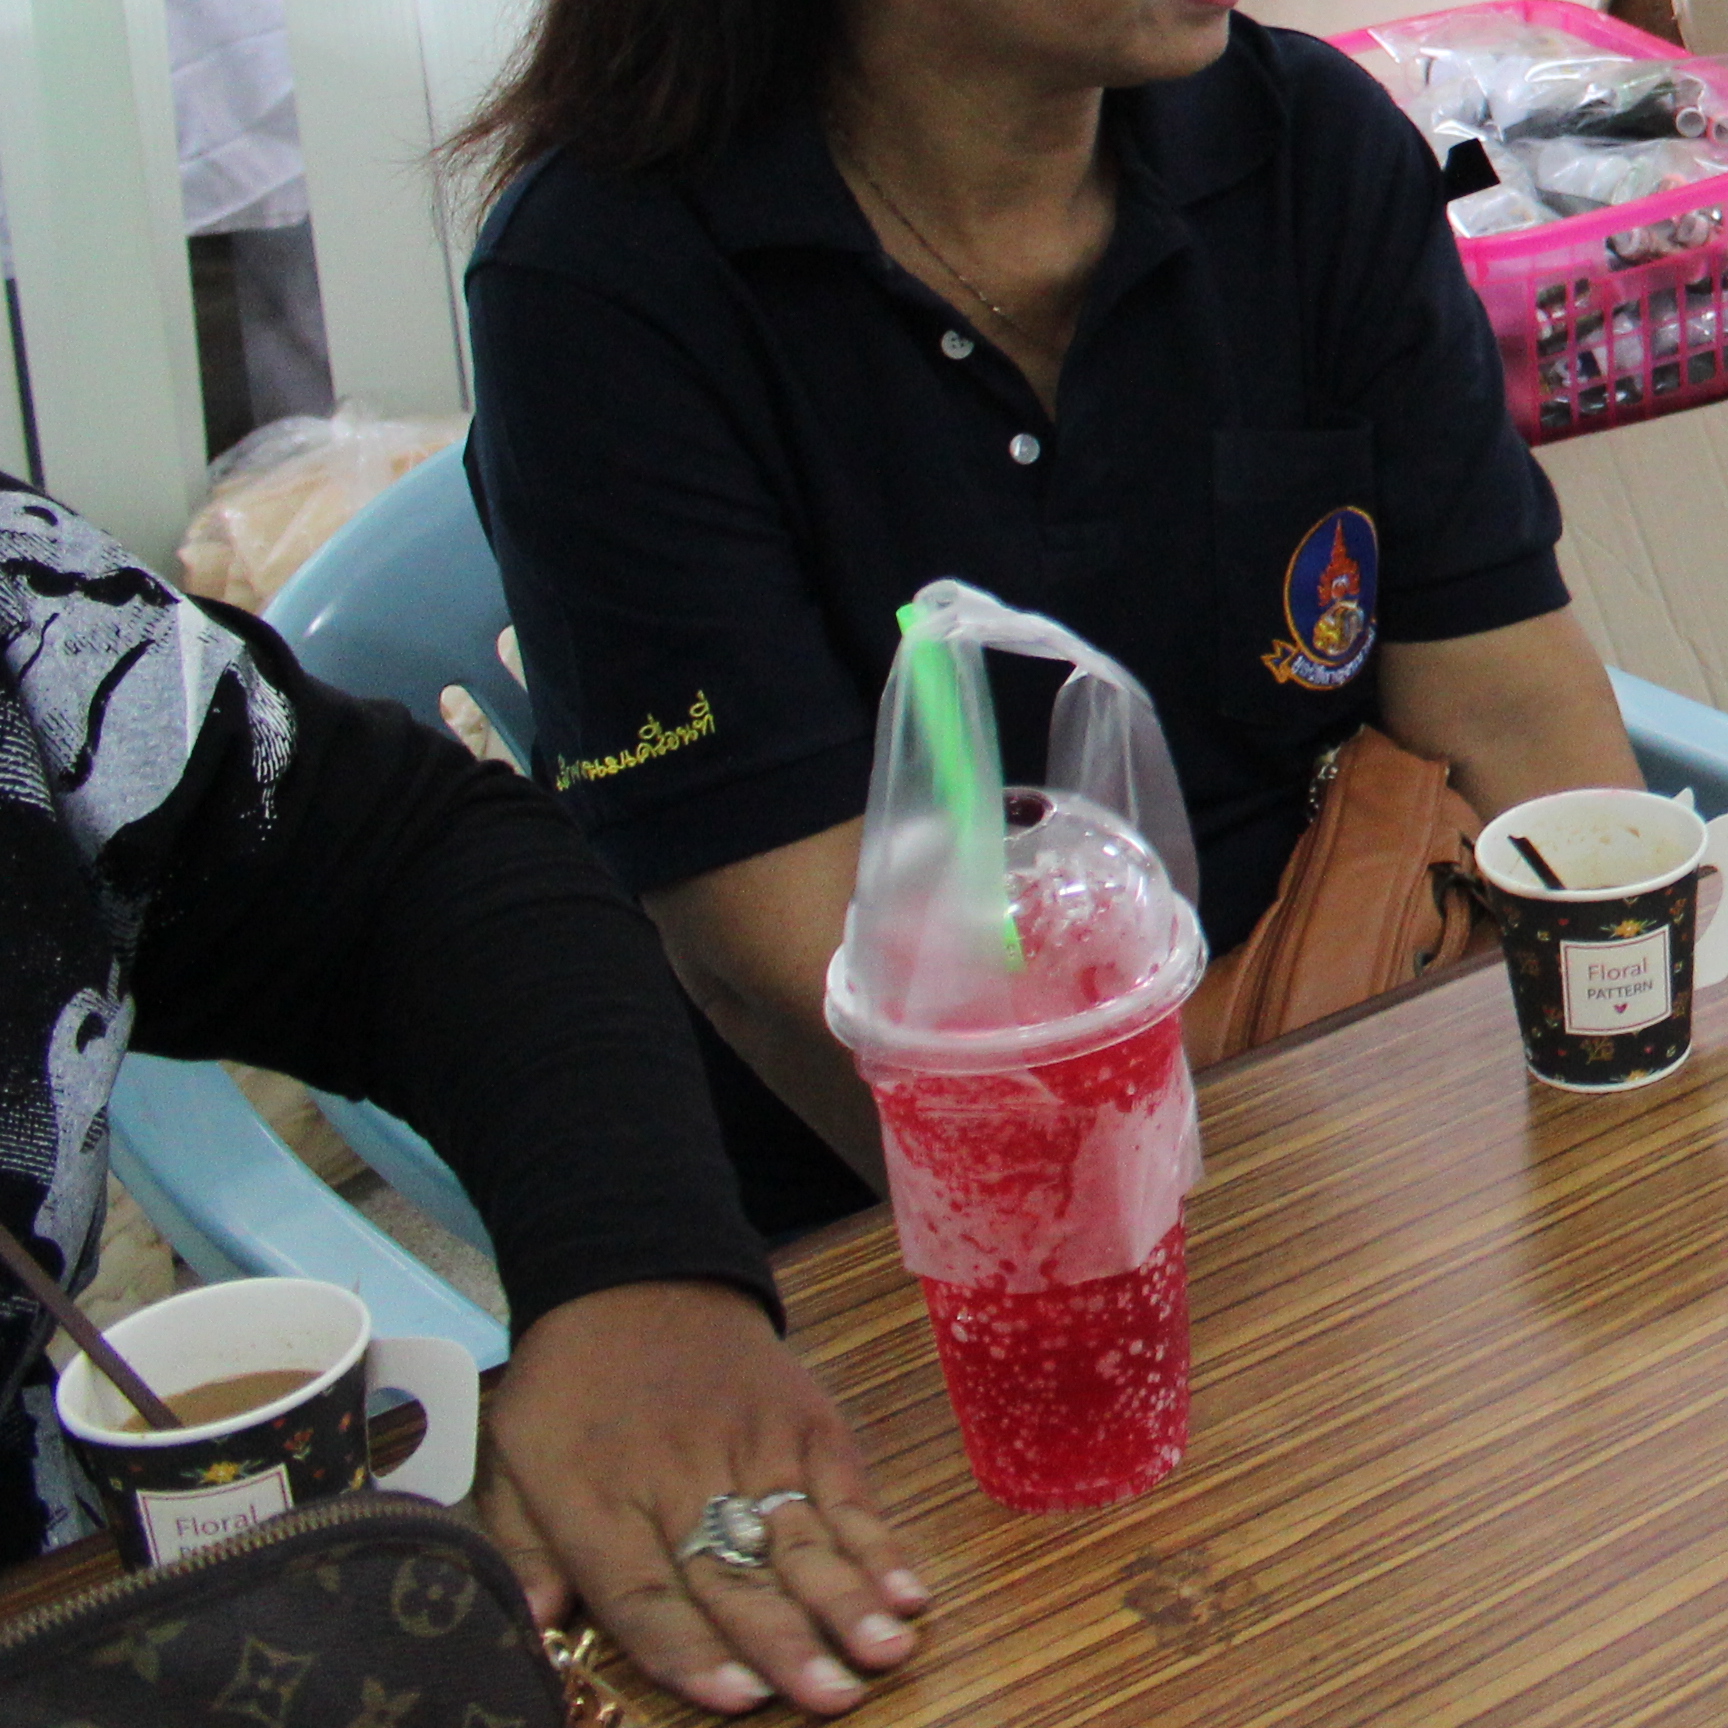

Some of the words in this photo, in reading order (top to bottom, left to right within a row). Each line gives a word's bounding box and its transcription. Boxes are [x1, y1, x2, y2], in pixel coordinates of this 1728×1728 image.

[1587, 957, 1648, 983] Floral
[1586, 978, 1654, 1001] PATTERN
[175, 1503, 258, 1537] Floral
